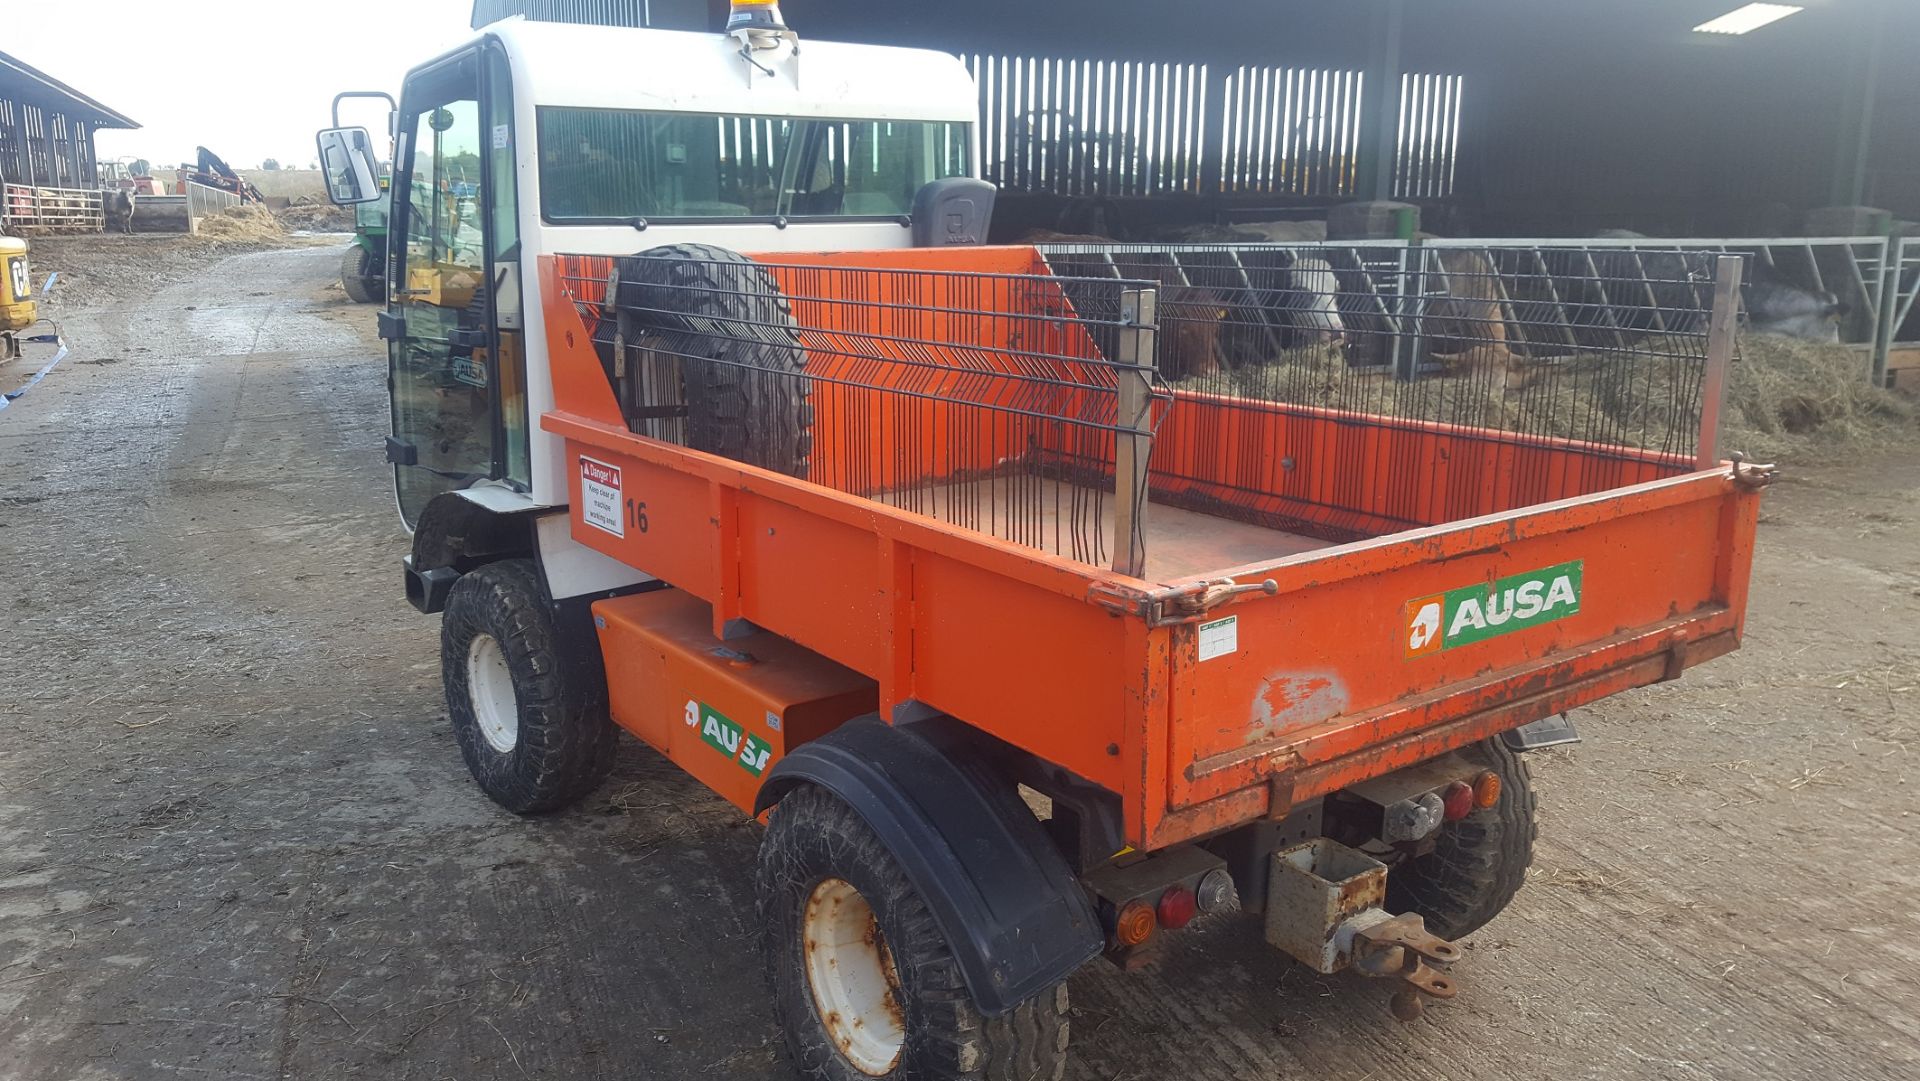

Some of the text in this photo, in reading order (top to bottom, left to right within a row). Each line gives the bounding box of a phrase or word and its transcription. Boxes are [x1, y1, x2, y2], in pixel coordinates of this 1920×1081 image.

[589, 484, 599, 496] Keep
[600, 488, 609, 498] clear
[589, 511, 606, 524] working
[627, 498, 648, 533] 16
[1447, 575, 1577, 637] AUSA
